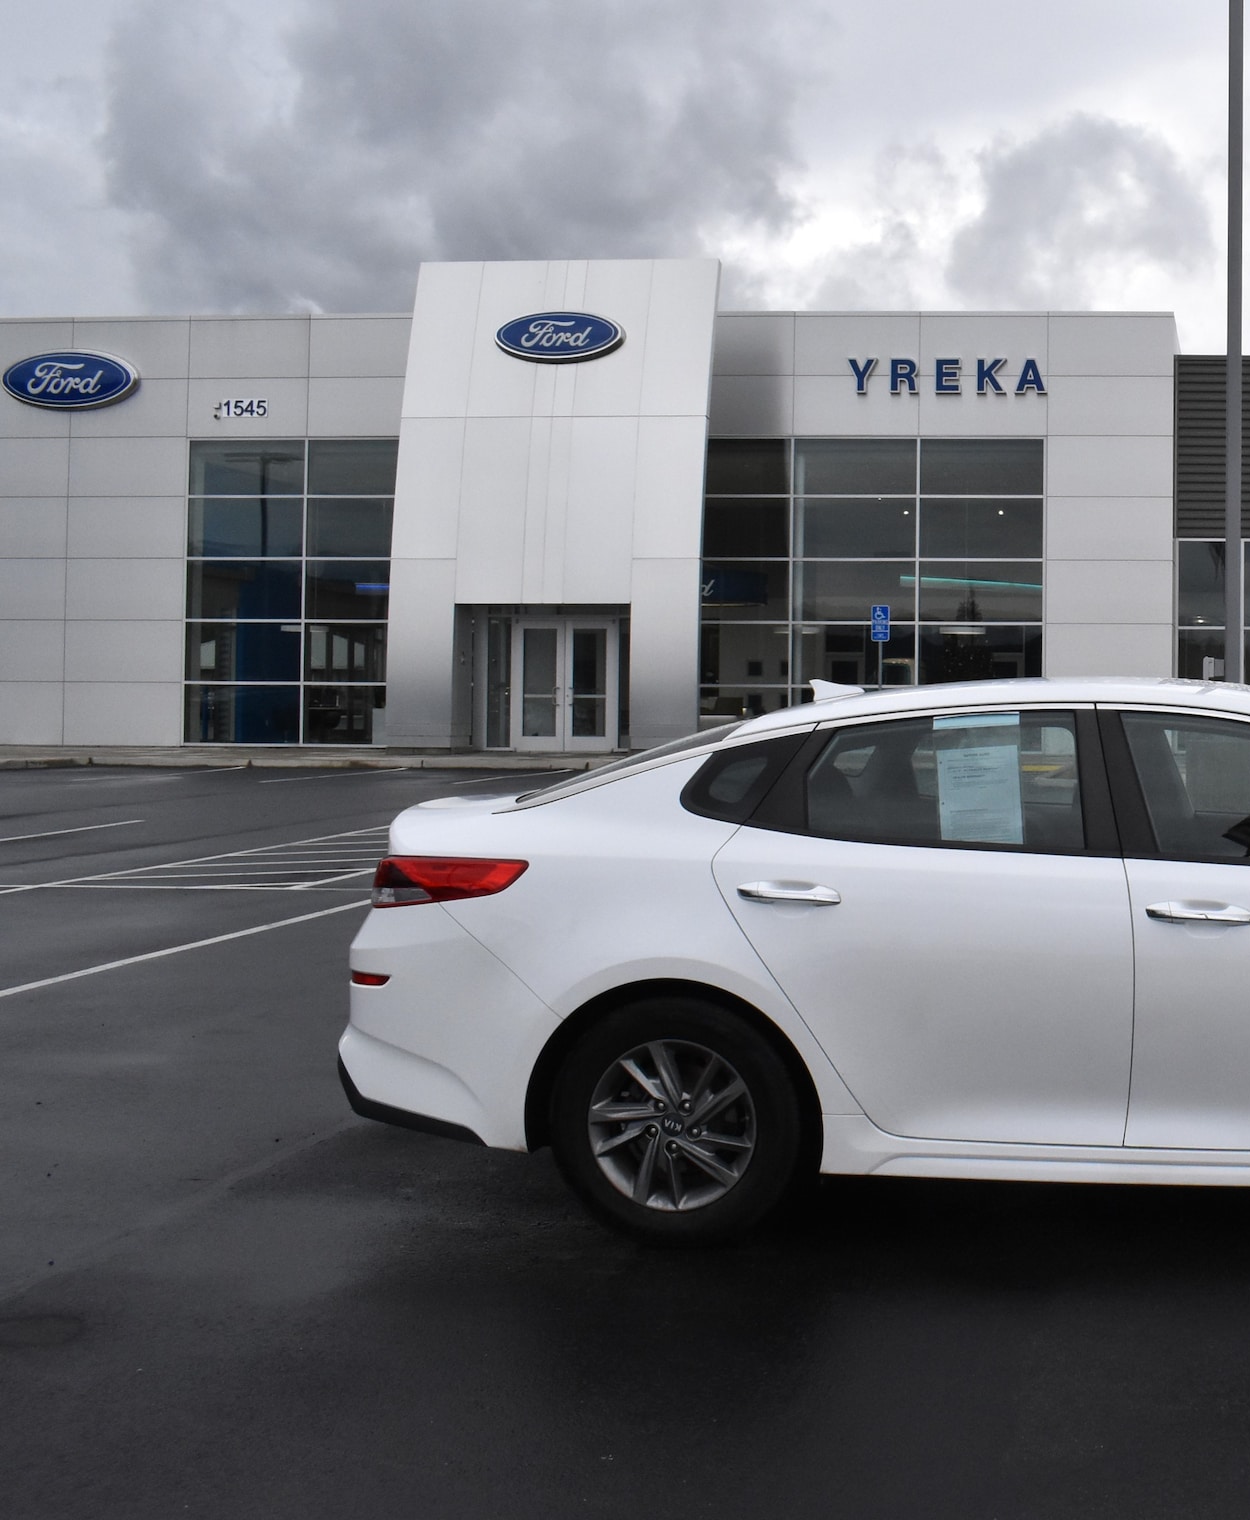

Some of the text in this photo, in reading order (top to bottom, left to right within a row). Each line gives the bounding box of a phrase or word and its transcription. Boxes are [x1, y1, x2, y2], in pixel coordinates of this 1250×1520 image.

[520, 319, 593, 348] Ford
[26, 361, 103, 395] Ford
[848, 357, 1049, 395] YREKA
[223, 400, 267, 417] 1545
[664, 1118, 682, 1132] KIA
